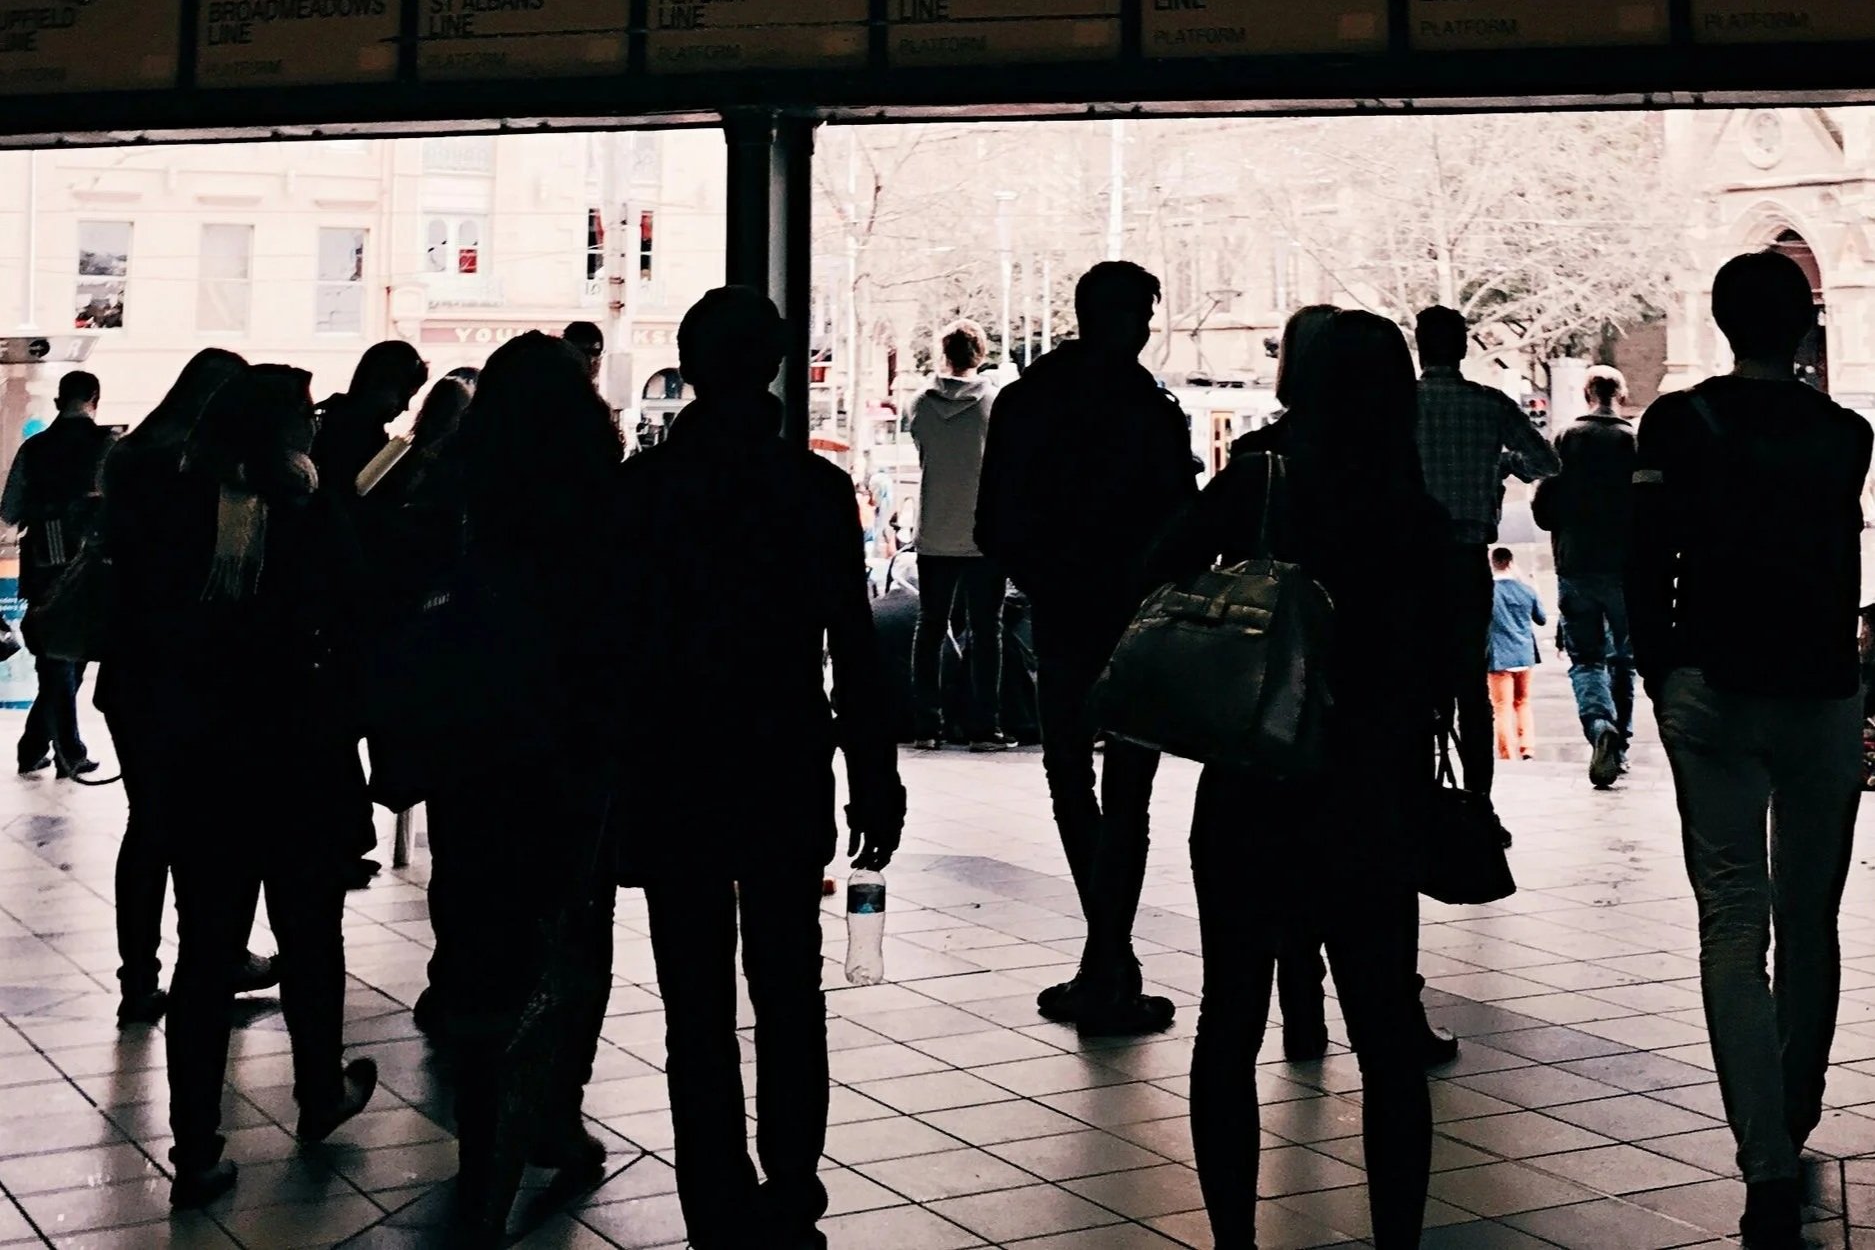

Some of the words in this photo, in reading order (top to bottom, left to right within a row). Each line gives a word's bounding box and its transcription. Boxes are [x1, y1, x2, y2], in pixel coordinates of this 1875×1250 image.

[429, 13, 475, 37] LINE
[657, 6, 706, 30] LINE
[1420, 18, 1519, 37] PLATFORM
[207, 23, 253, 47] LINE
[1153, 26, 1247, 46] PLATFORM
